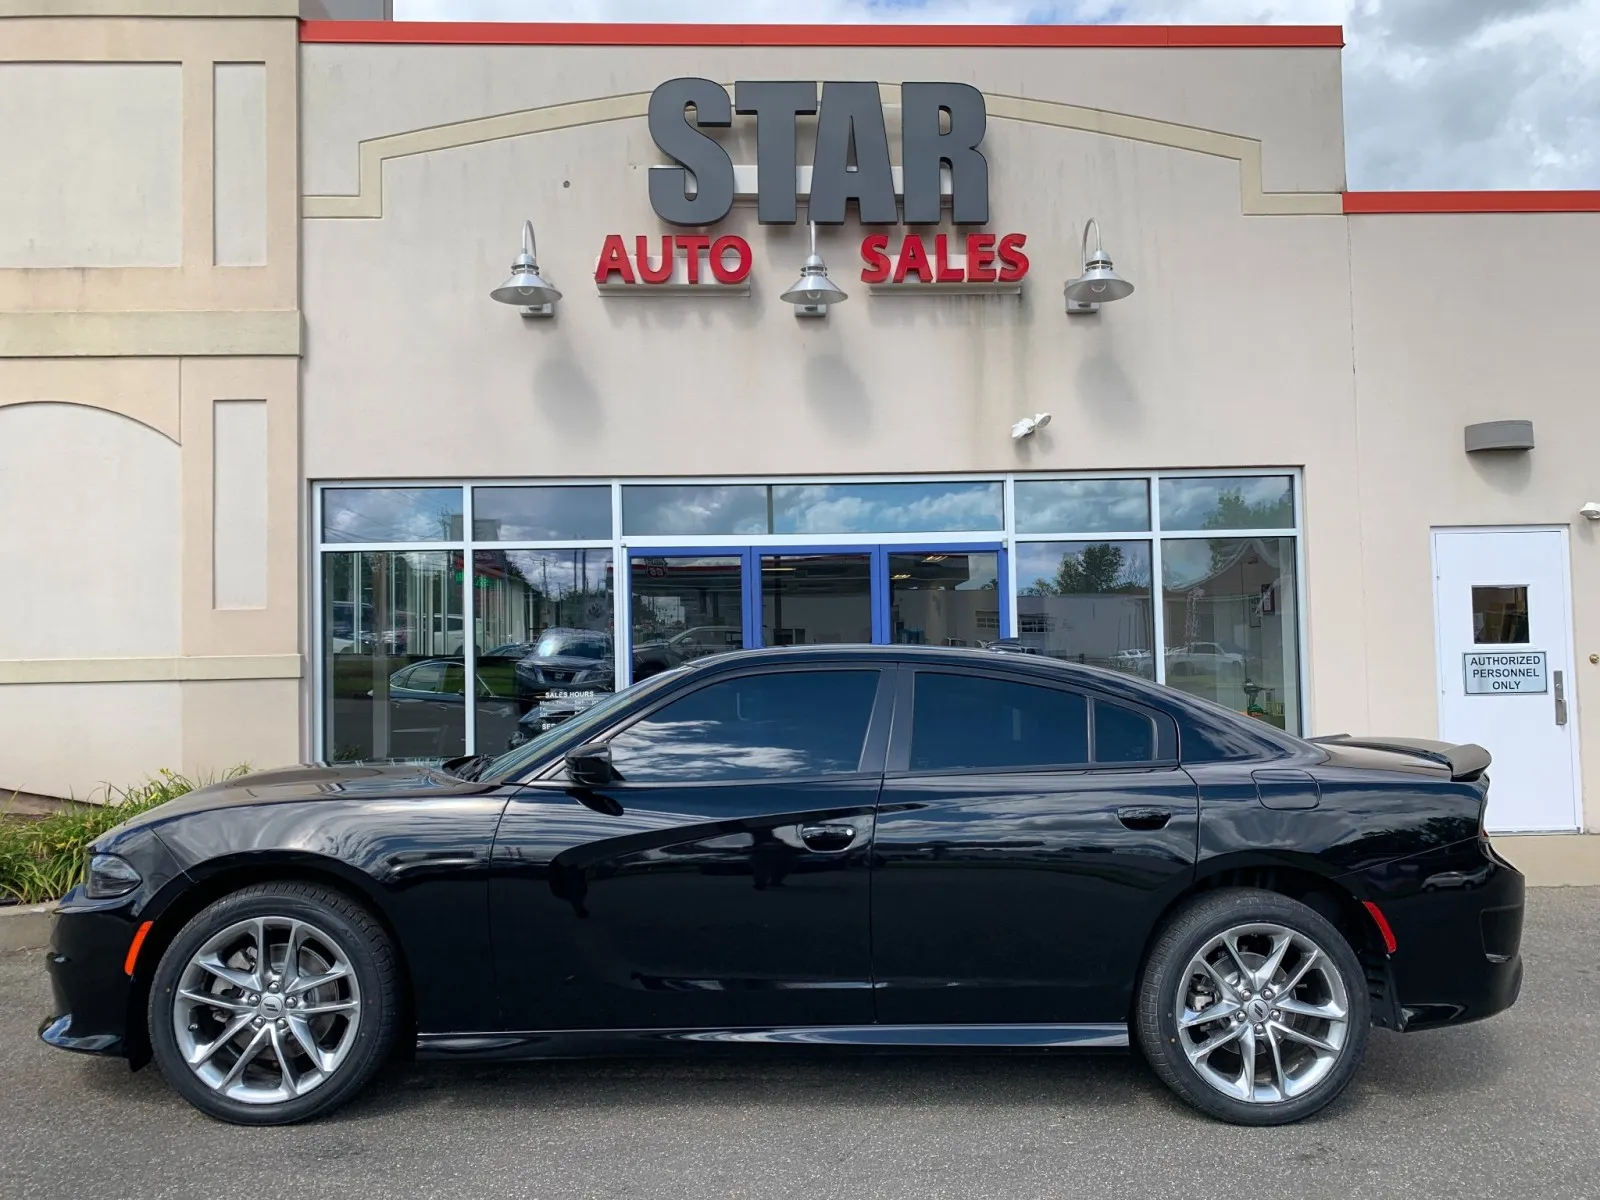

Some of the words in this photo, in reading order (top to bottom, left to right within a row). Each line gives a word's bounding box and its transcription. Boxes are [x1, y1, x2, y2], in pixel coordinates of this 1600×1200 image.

[648, 77, 989, 226] STAR
[595, 234, 753, 285] AUTO
[860, 233, 1030, 284] SALES
[1470, 655, 1541, 666] AUTHORIZED
[1472, 668, 1540, 678] PERSONNEL
[1492, 680, 1521, 690] ONLY
